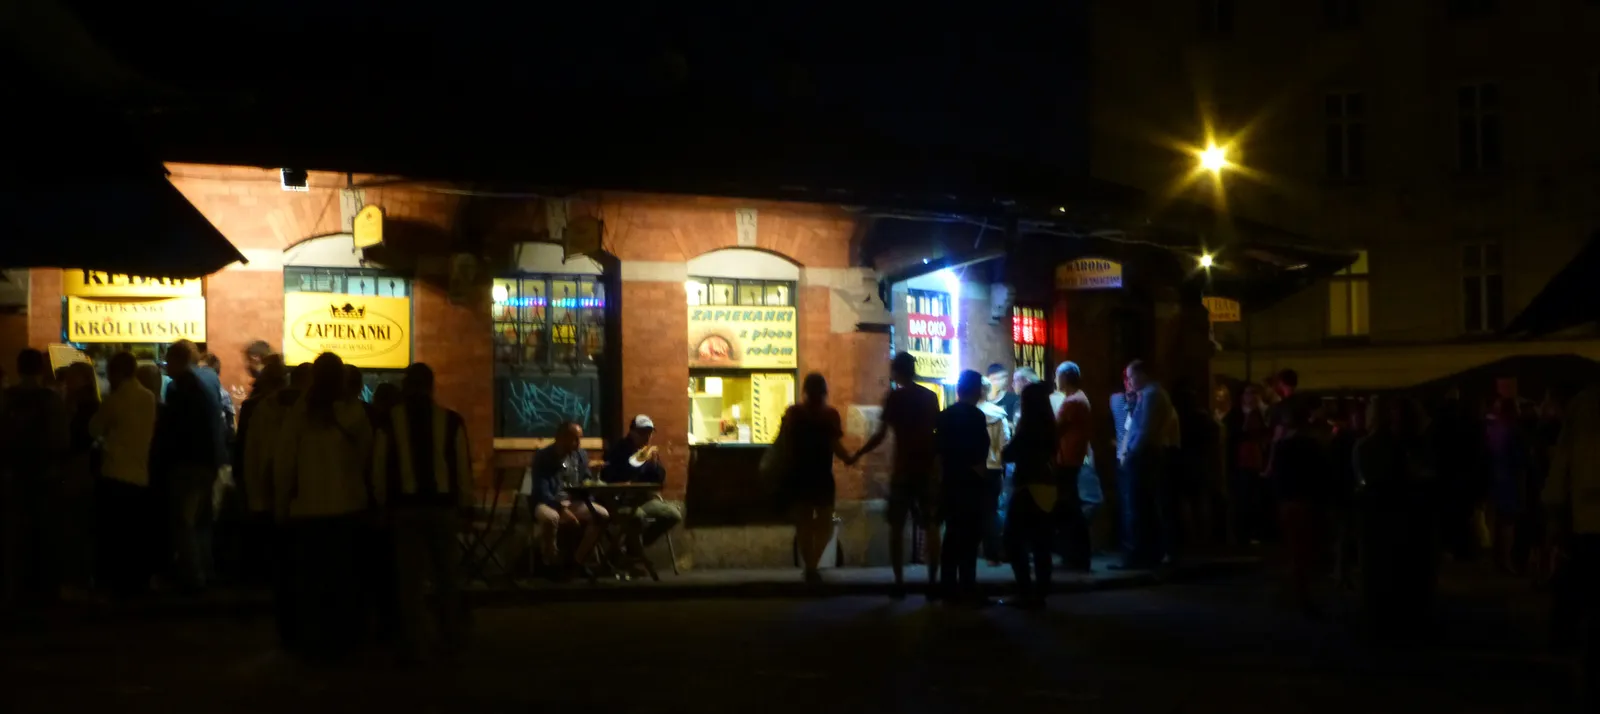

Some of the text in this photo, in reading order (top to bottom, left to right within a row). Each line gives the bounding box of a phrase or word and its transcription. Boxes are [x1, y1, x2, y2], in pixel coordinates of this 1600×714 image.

[691, 310, 794, 321] ZAPIEKANKI
[305, 323, 391, 341] ZAPIEKANKI
[746, 344, 793, 355] rodem
